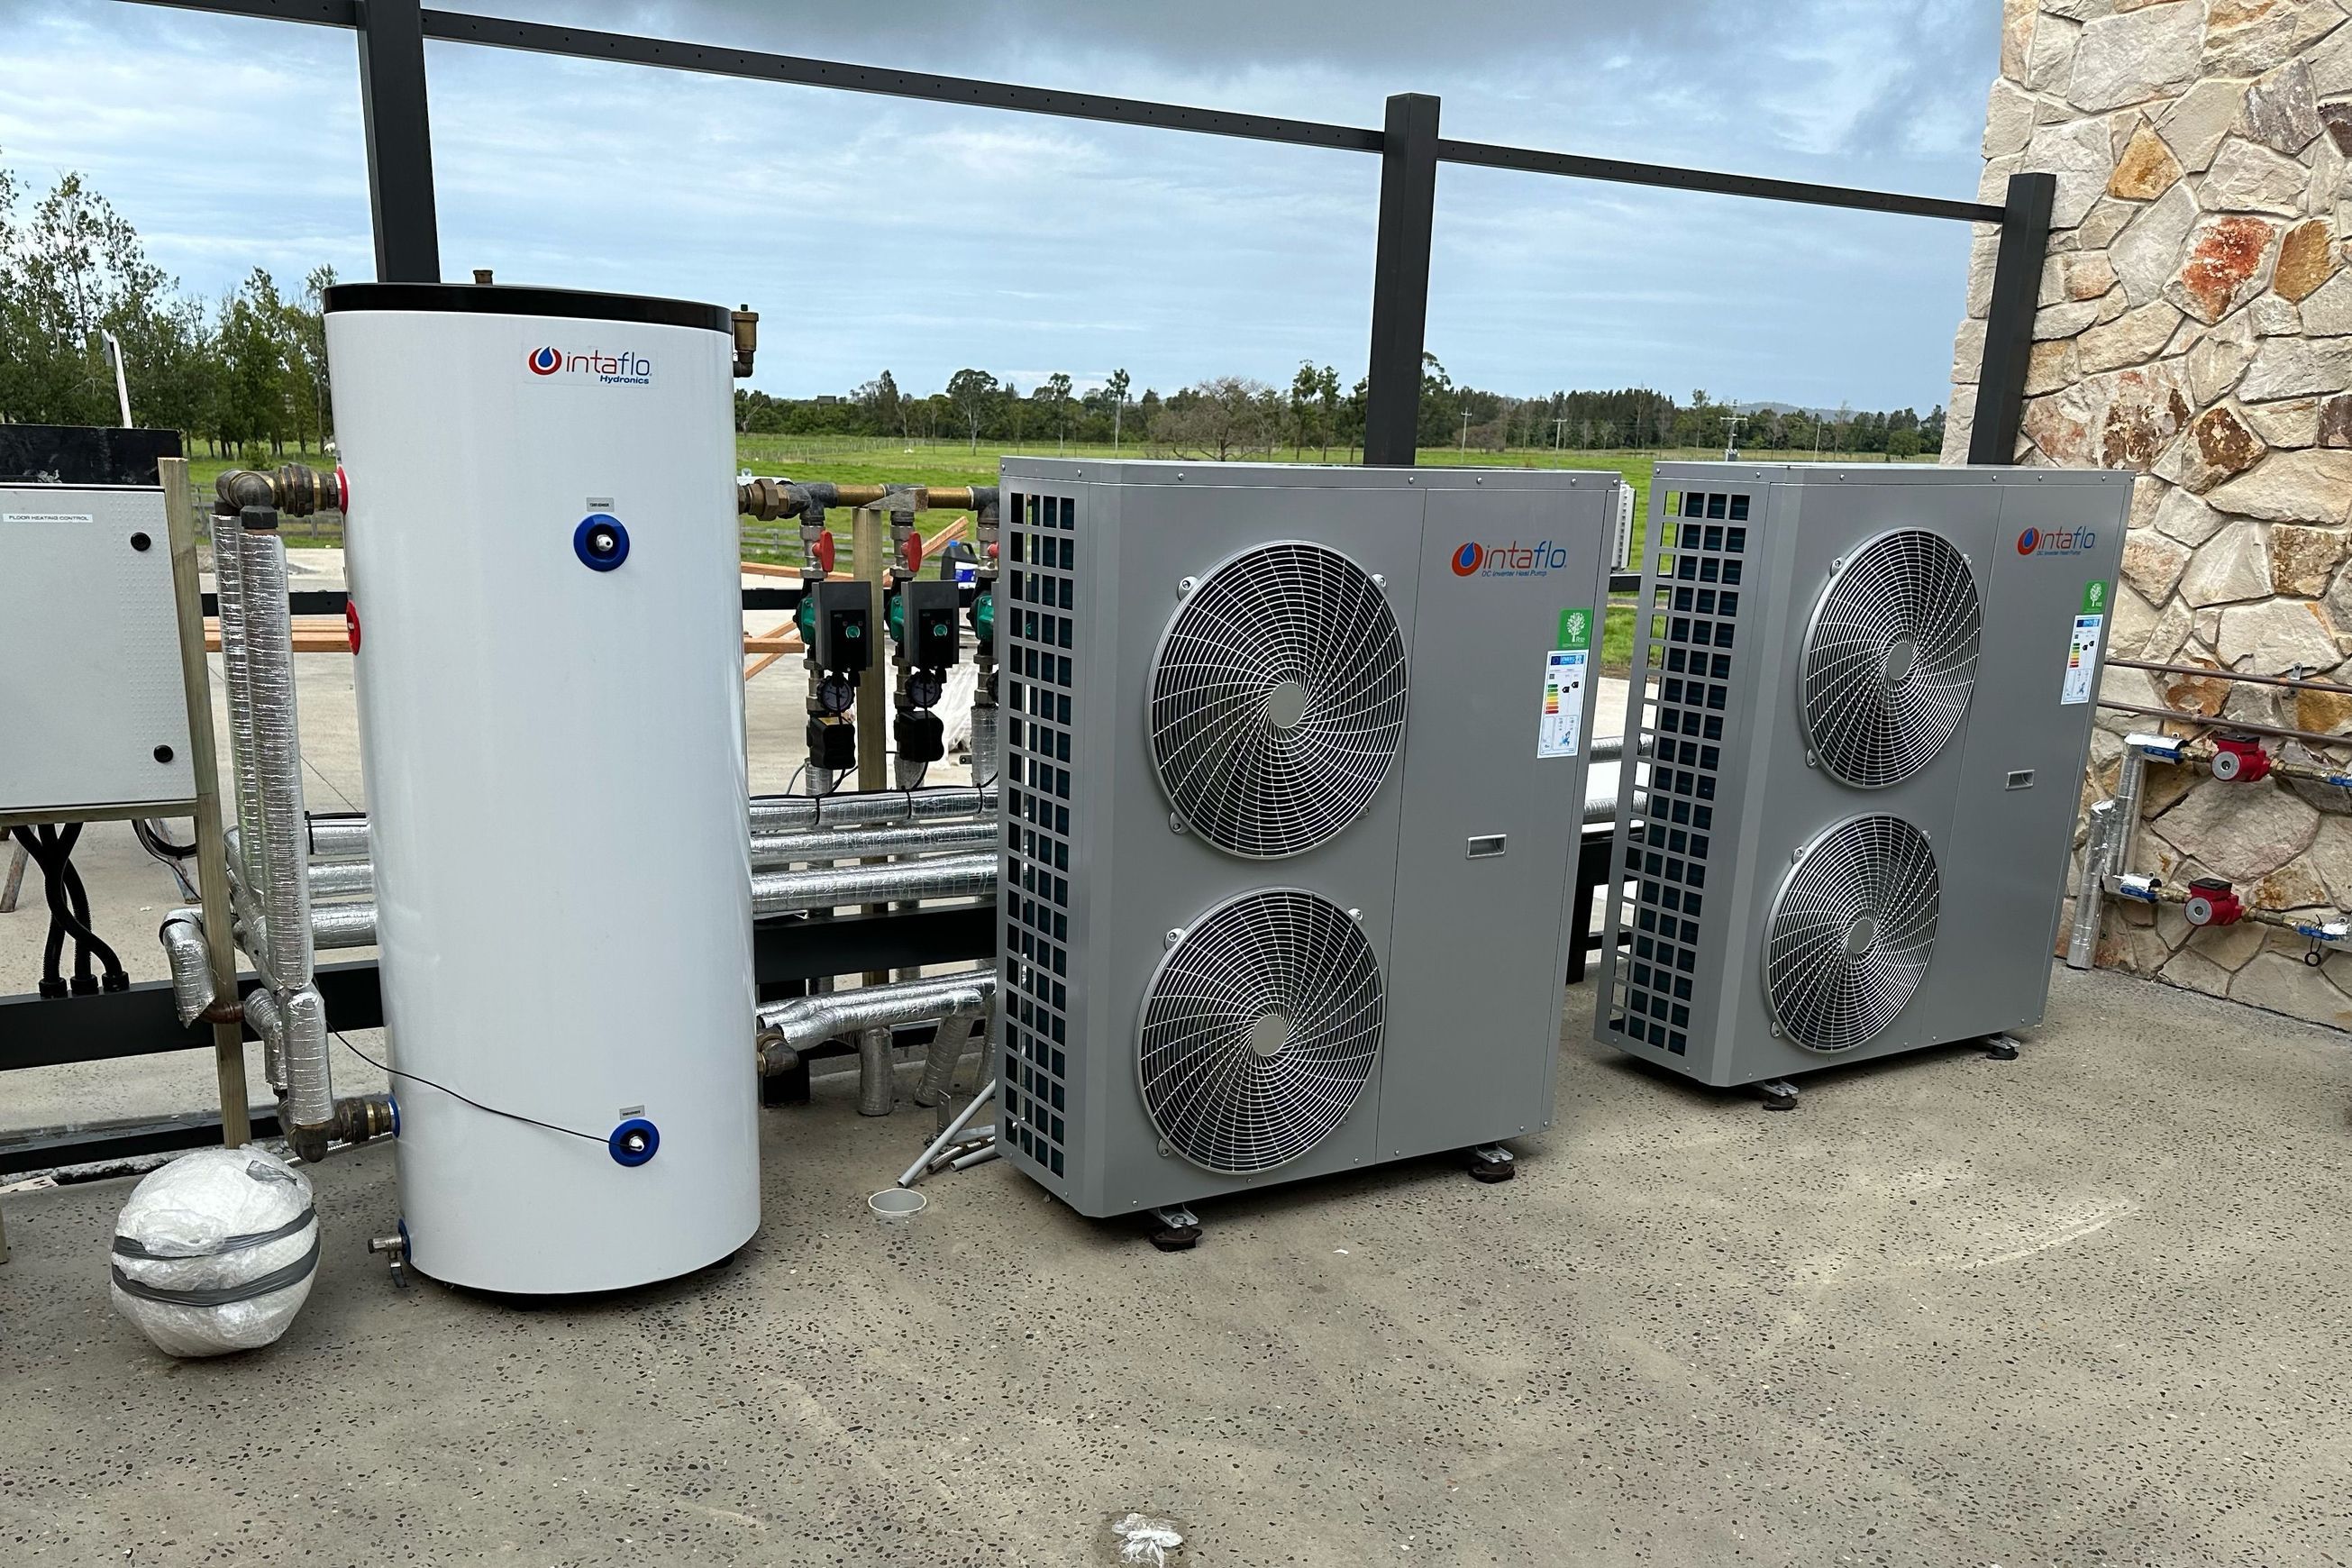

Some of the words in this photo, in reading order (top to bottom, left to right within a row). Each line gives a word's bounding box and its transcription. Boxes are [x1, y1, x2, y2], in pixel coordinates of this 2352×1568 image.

[566, 350, 651, 376] intaflo
[600, 375, 650, 384] Hydronics
[2037, 526, 2096, 550] intaflo
[1482, 541, 1567, 569] intaflo
